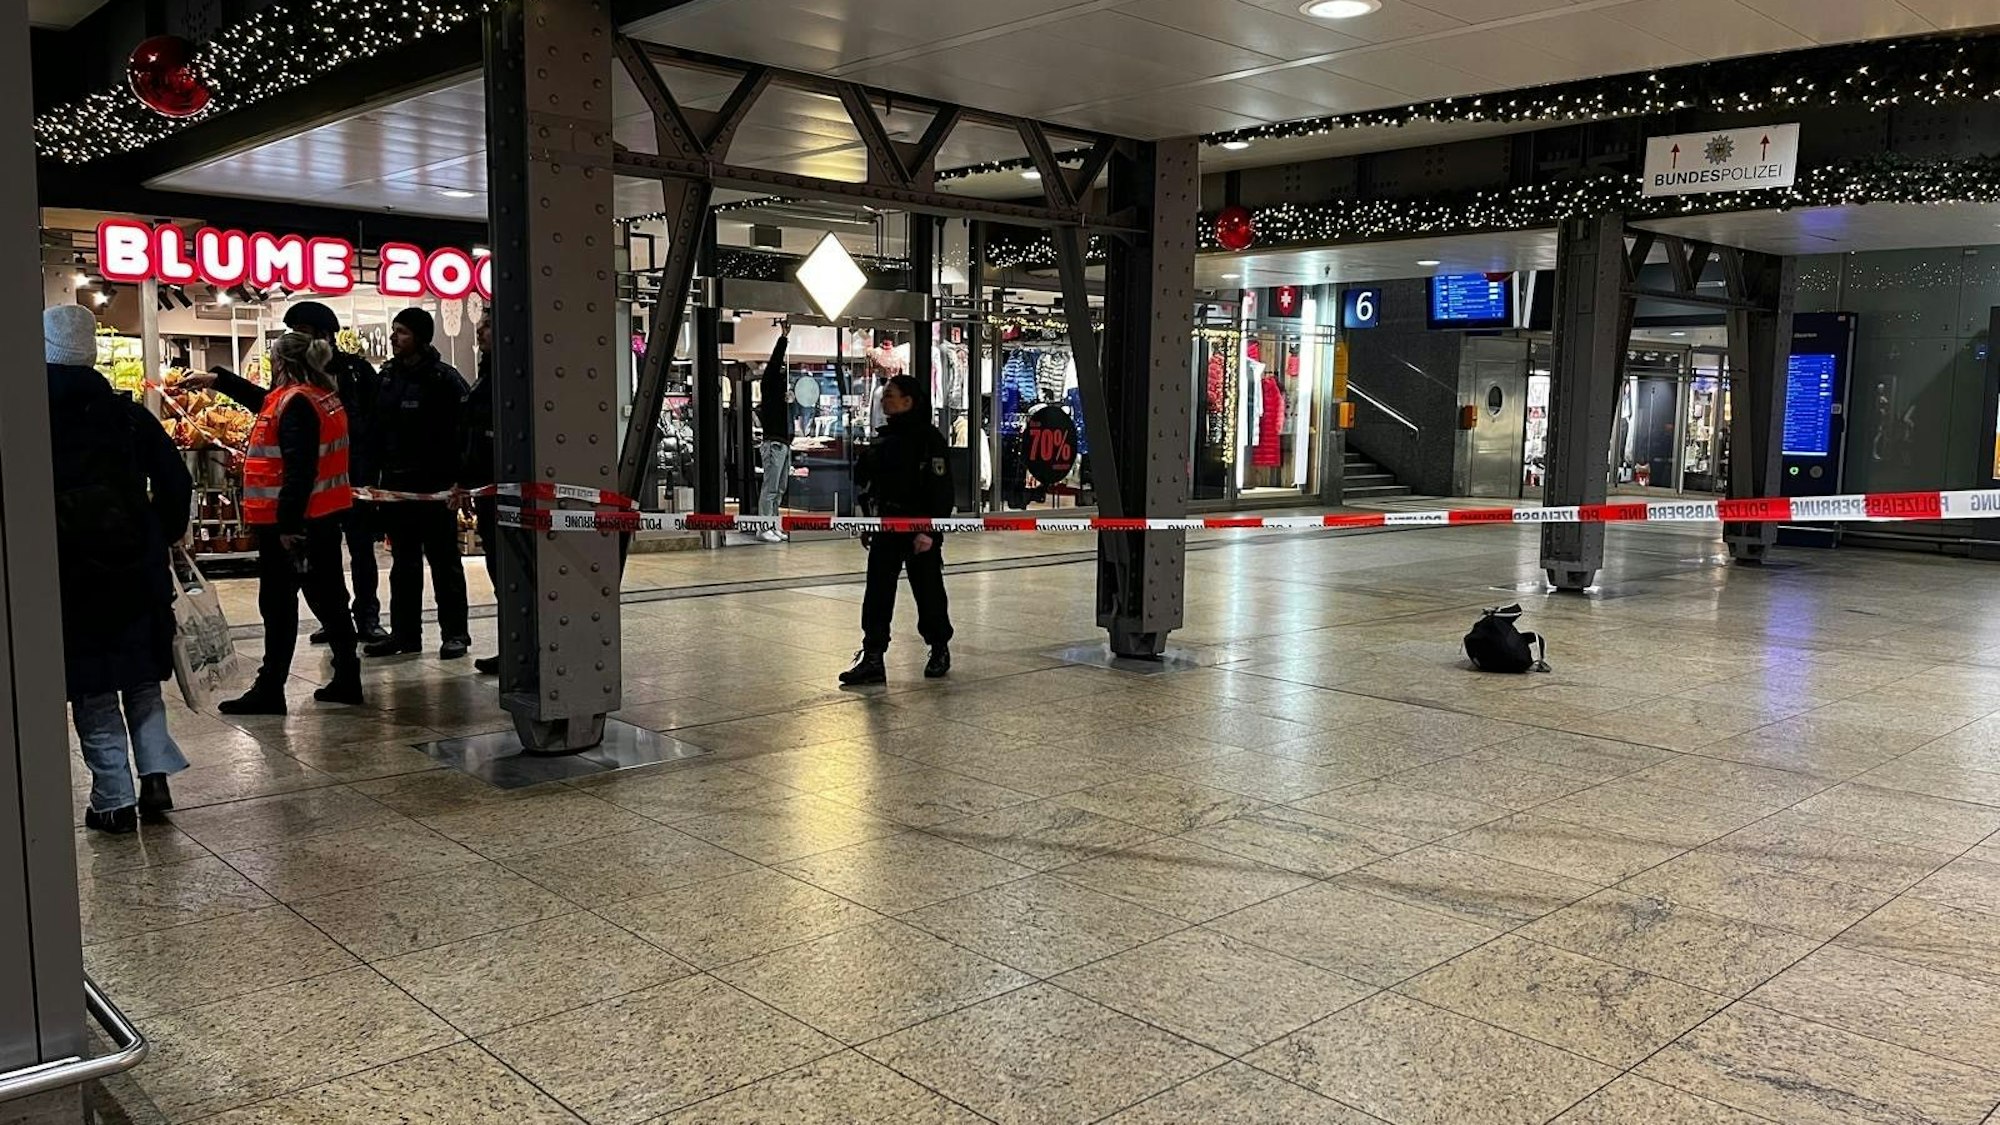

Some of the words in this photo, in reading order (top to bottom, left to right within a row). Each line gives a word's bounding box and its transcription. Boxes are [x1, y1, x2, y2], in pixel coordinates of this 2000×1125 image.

[1654, 163, 1783, 187] BUNDESPOLIZEI
[97, 219, 353, 293] BLUME
[379, 241, 491, 299] 20
[1355, 291, 1374, 321] 6
[1029, 429, 1071, 461] 70%
